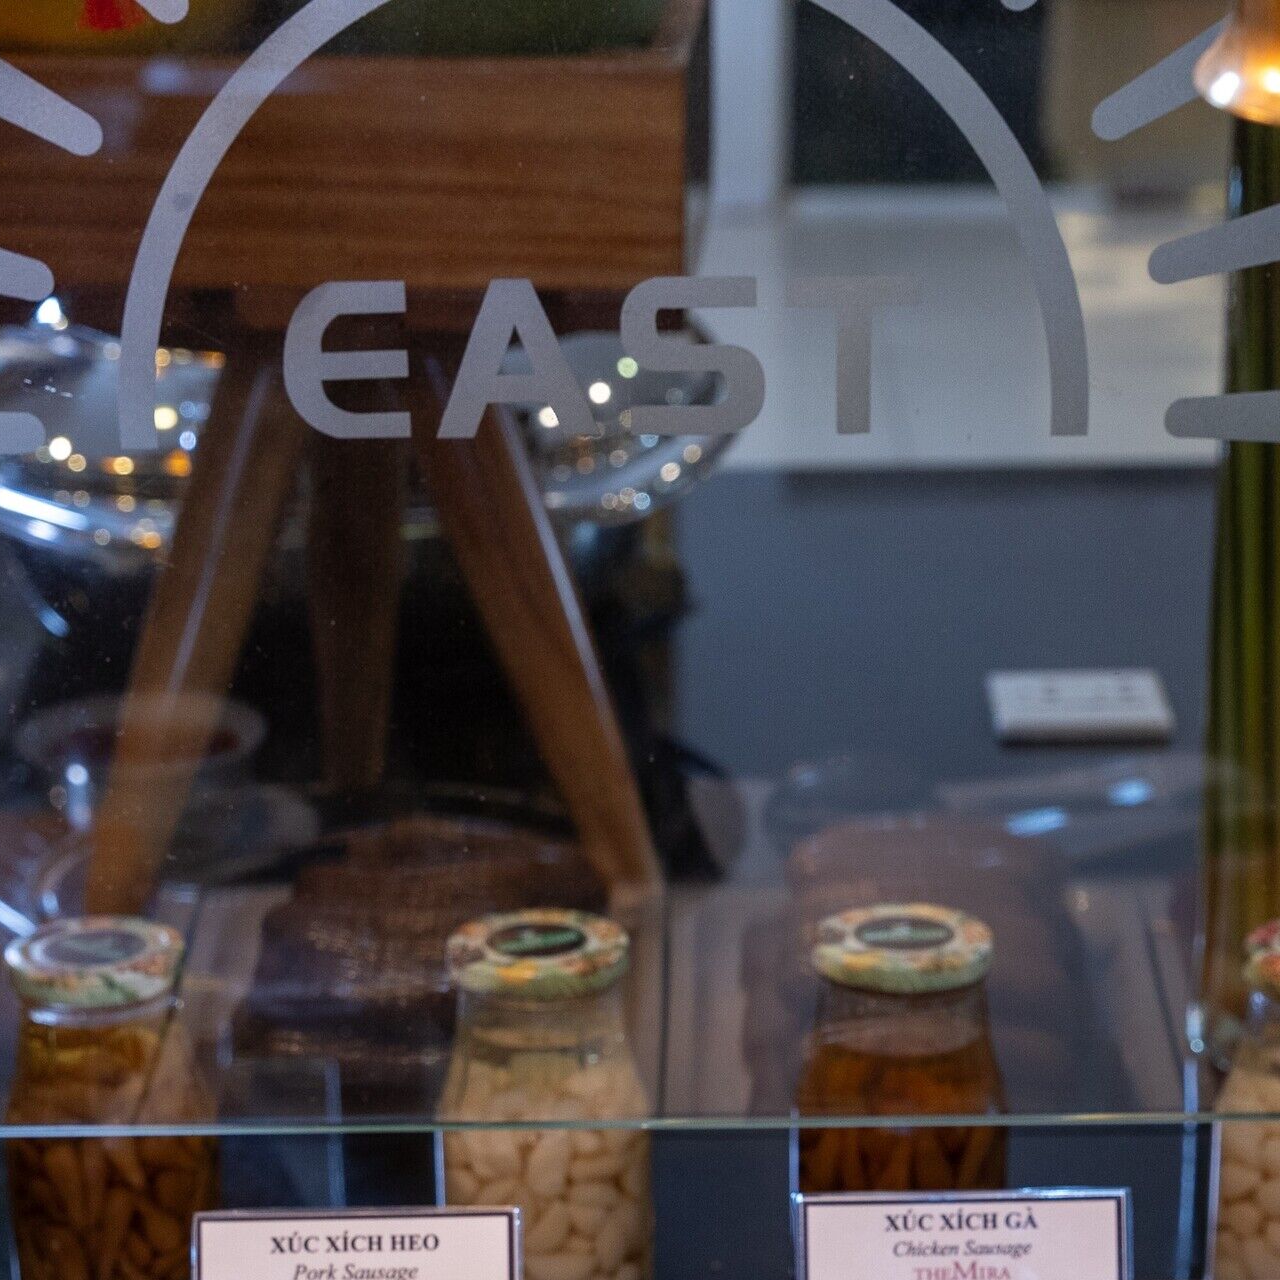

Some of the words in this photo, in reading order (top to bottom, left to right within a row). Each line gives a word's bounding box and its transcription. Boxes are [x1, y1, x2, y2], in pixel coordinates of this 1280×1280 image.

[282, 275, 920, 439] EAST
[885, 1210, 933, 1232] XÚC
[939, 1208, 998, 1231] XÍCH
[1005, 1206, 1038, 1230] GÀ
[270, 1230, 320, 1254] XÚC
[325, 1230, 382, 1252] XÍCH
[390, 1233, 440, 1251] HEO
[892, 1241, 960, 1257] Chicken
[964, 1240, 1031, 1258] Sausage
